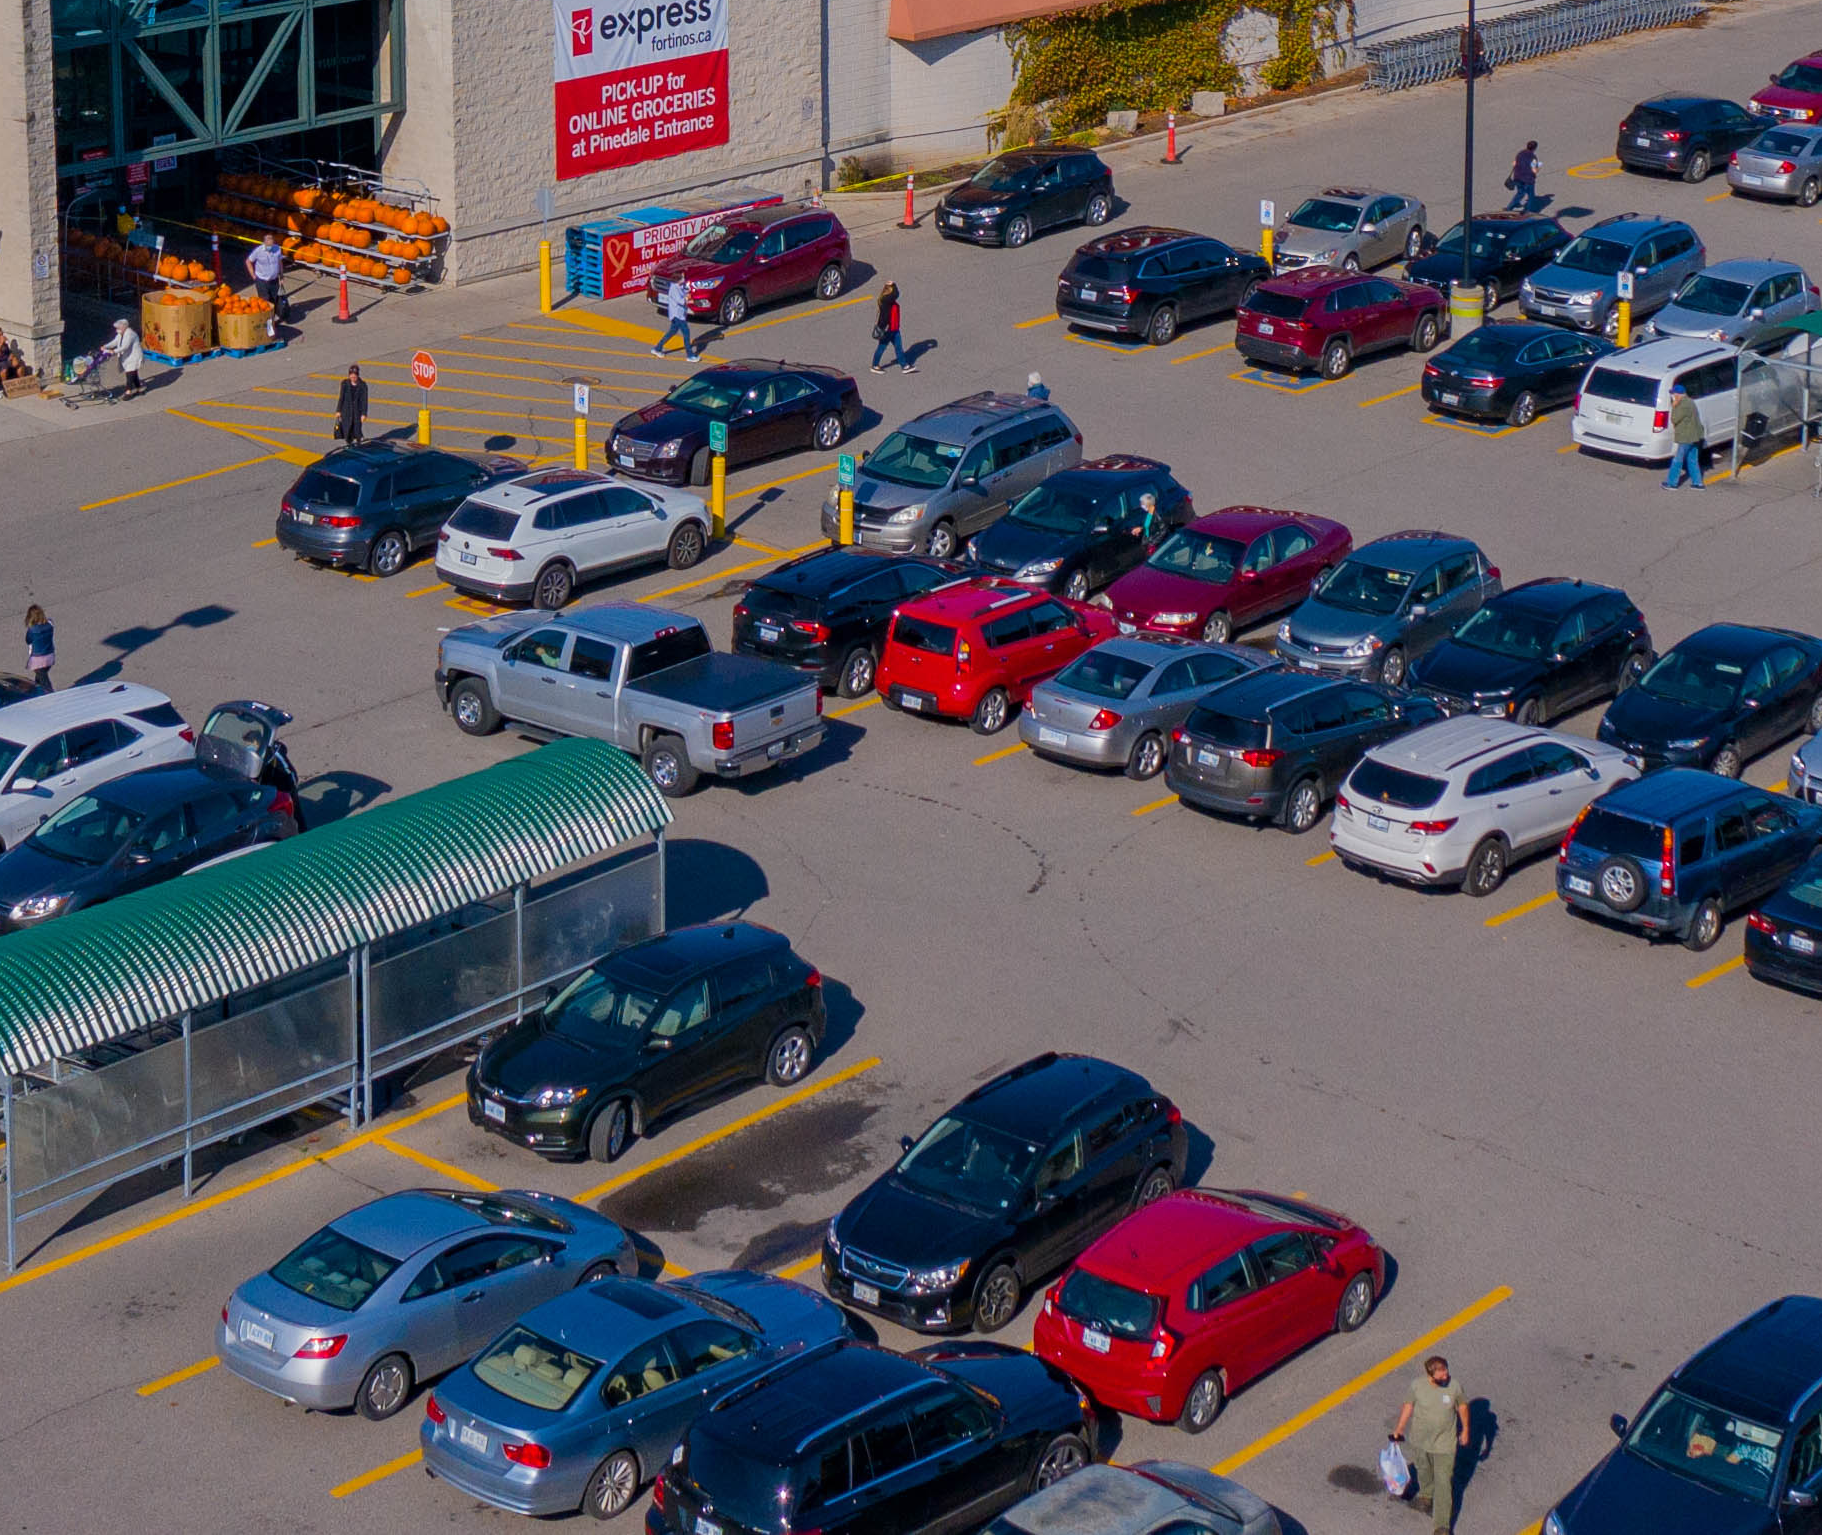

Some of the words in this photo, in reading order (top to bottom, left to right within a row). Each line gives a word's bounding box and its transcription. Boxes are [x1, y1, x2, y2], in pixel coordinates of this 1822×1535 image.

[652, 29, 711, 52] fortinos.ca
[601, 74, 664, 104] PICK-UP
[667, 72, 686, 90] for
[569, 105, 628, 135] ONLINE
[631, 87, 716, 121] GROCERIES
[571, 138, 587, 157] at
[589, 125, 650, 153] Pinedale
[654, 114, 714, 140] Entrance
[644, 220, 697, 244] PRIORITY
[641, 246, 655, 261] for
[413, 361, 435, 379] STOP
